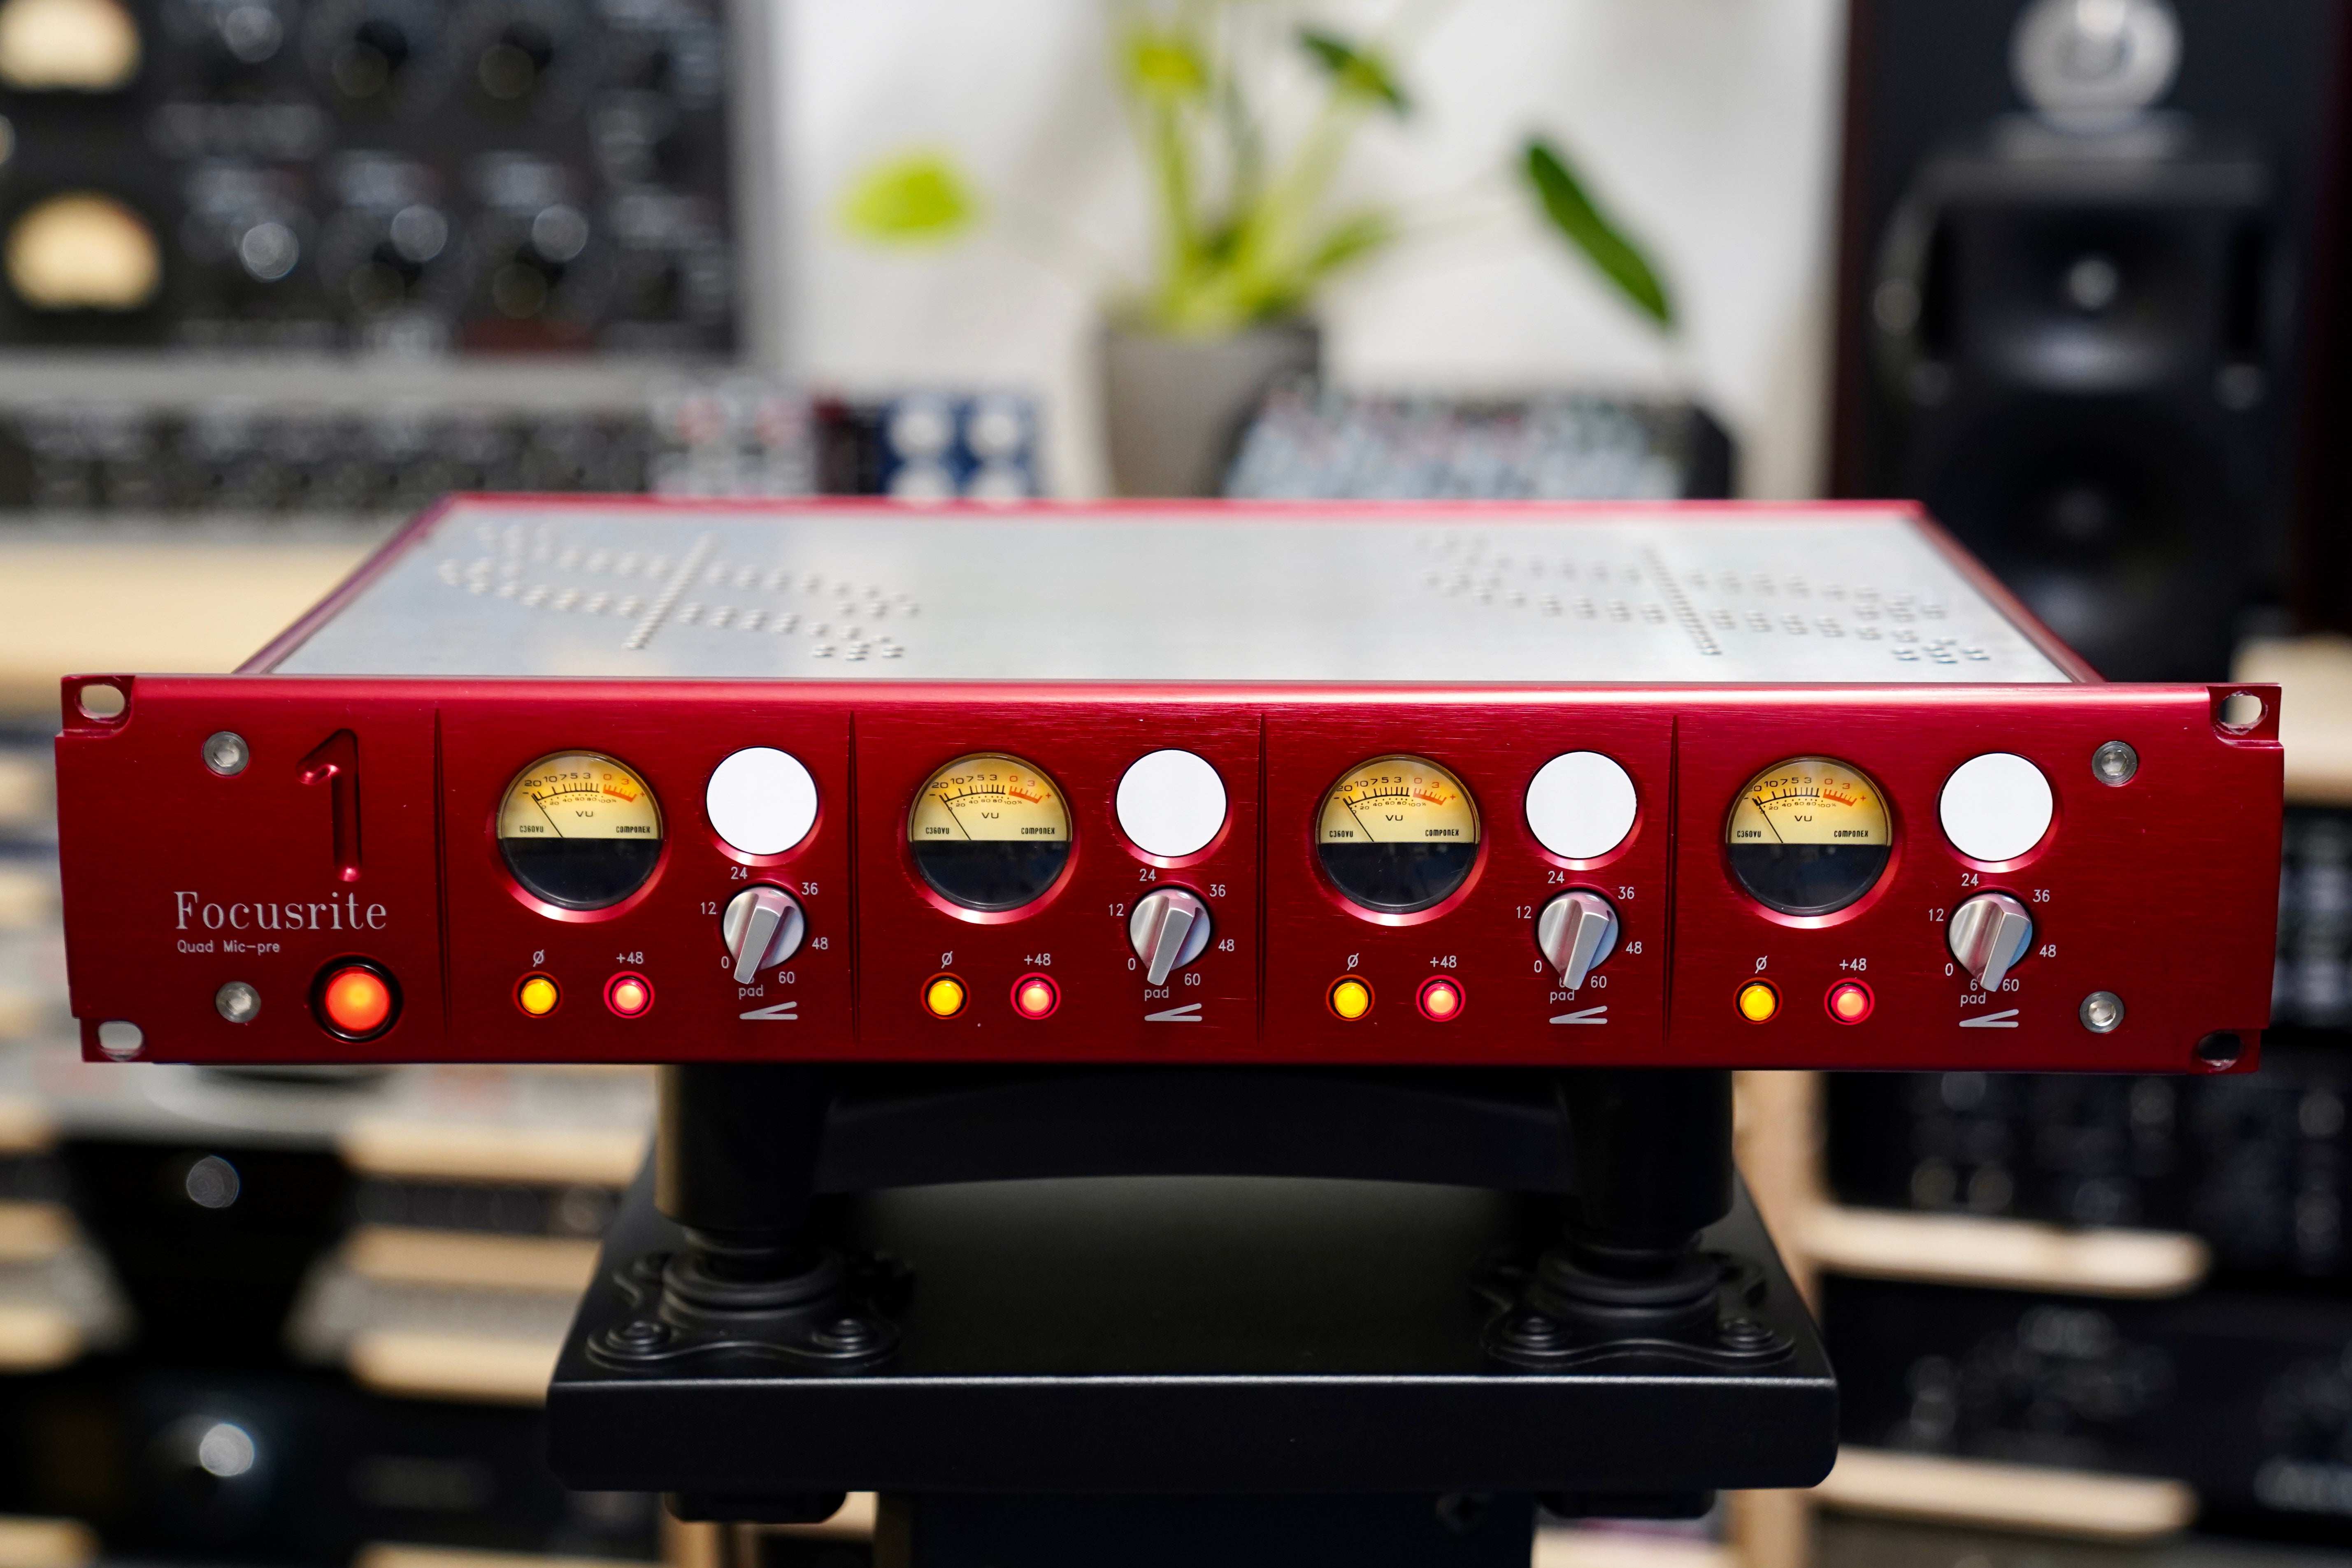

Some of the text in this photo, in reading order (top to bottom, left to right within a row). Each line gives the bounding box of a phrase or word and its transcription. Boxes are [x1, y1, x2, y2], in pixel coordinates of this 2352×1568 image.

[731, 866, 748, 880] 24
[1139, 868, 1156, 881] 24
[1548, 871, 1565, 884] 24
[1961, 873, 1979, 886] 24
[801, 882, 818, 895] 36
[1209, 884, 1226, 897] 36
[1618, 886, 1635, 899] 36
[2033, 889, 2050, 902] 36
[174, 891, 386, 929] Focusrite
[700, 901, 716, 915] 12
[1109, 904, 1124, 916] 12
[1516, 906, 1532, 919] 12
[1929, 908, 1944, 922] 12
[177, 939, 280, 956] Quad Mic-pre
[811, 937, 828, 950] 48
[1218, 939, 1234, 952] 48
[1625, 941, 1642, 954] 48
[2039, 944, 2056, 957] 48
[616, 951, 644, 964] +48
[721, 956, 729, 969] 0
[1024, 953, 1051, 966] +48
[1430, 955, 1457, 968] +48
[1127, 958, 1136, 971] 0
[1534, 960, 1542, 973] 0
[1839, 958, 1866, 971] +48
[1945, 963, 1953, 976] 0
[779, 971, 795, 984] 60
[1184, 973, 1201, 986] 60
[1591, 976, 1607, 988] 60
[1970, 978, 1978, 991] 6
[2002, 978, 2020, 992] 60
[739, 984, 763, 1000] pad
[1144, 986, 1169, 1001] pad
[1550, 988, 1575, 1004] pad
[1960, 992, 1986, 1008] pad
